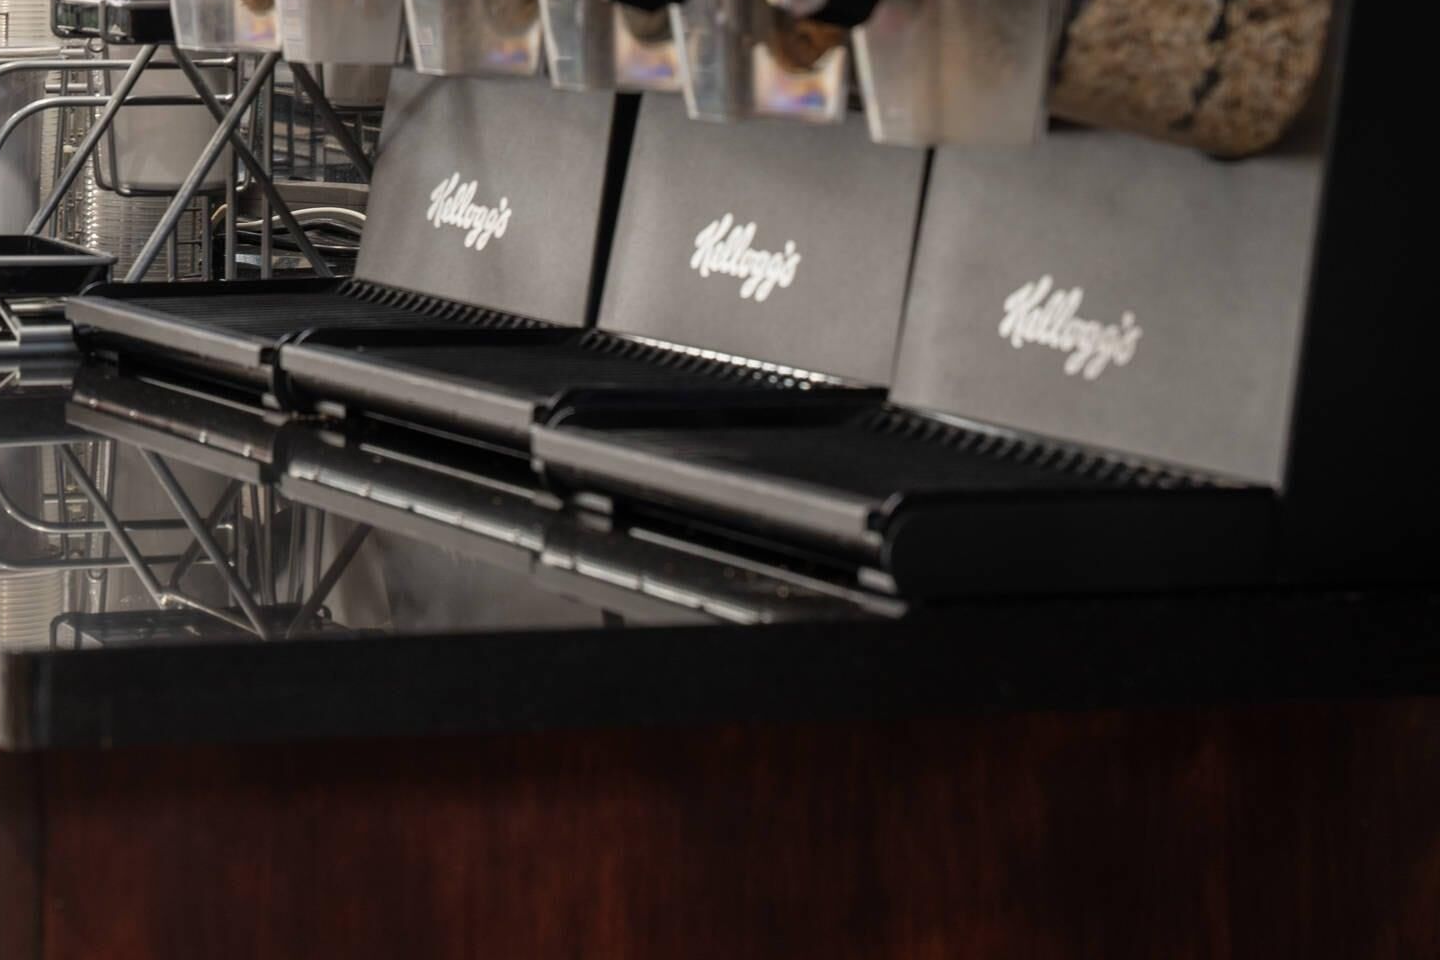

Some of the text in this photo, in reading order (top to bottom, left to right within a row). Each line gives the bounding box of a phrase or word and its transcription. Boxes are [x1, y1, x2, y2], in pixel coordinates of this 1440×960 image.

[426, 172, 512, 251] Kellogg's
[690, 212, 800, 302] Kellogg's
[998, 275, 1141, 380] Kellogg's
